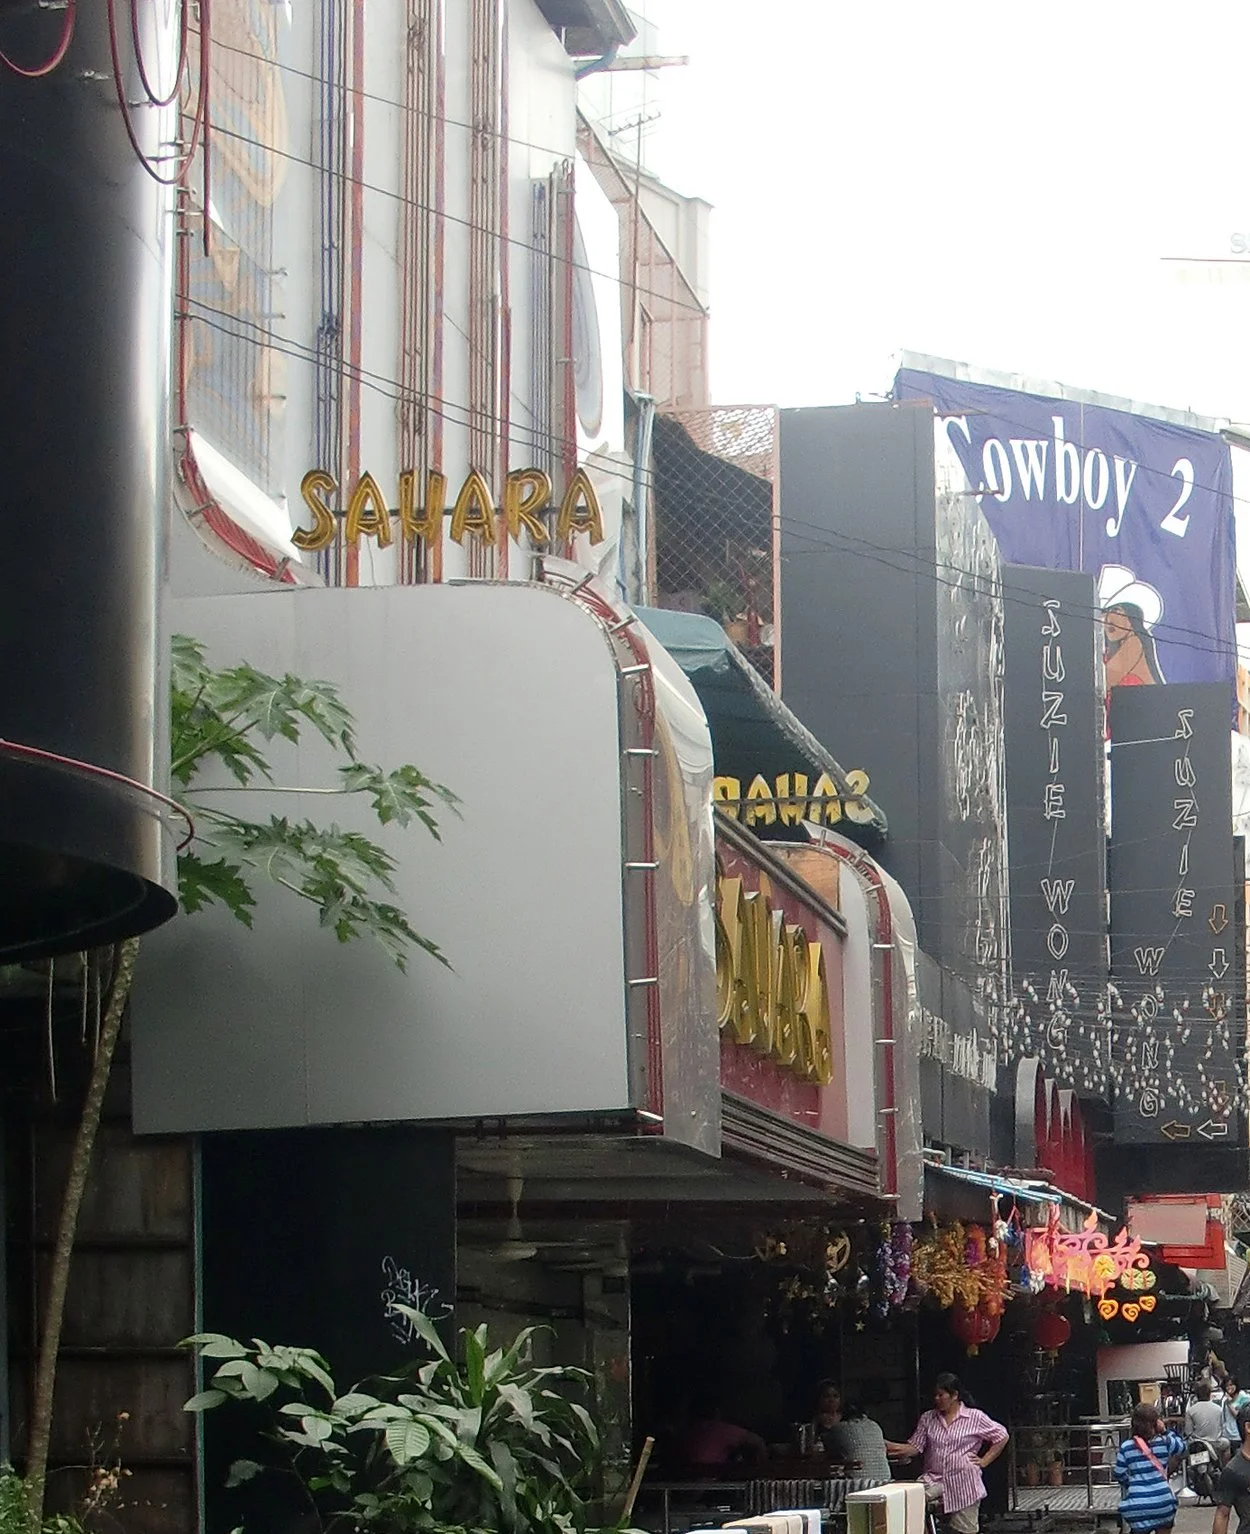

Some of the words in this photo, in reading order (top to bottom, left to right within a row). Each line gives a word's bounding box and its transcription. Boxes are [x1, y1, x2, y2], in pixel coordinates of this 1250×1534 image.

[291, 467, 605, 550] SAHARA
[1160, 457, 1194, 538] 2
[1041, 600, 1067, 819] SUZIE
[1173, 709, 1198, 918] SUZIE
[1040, 878, 1075, 1050] WONG
